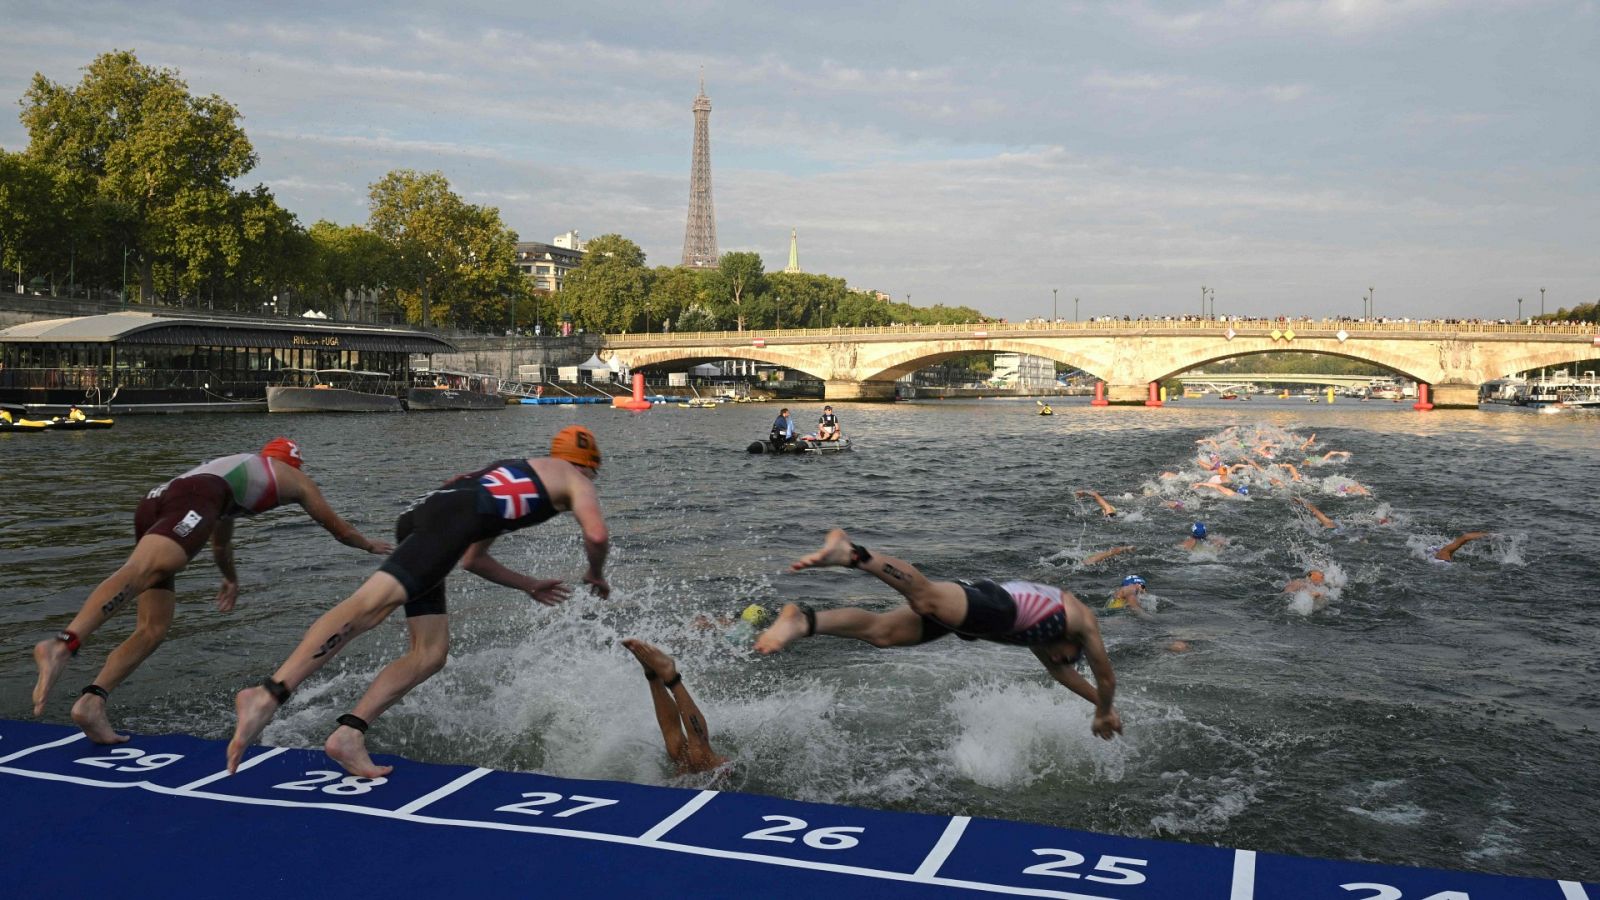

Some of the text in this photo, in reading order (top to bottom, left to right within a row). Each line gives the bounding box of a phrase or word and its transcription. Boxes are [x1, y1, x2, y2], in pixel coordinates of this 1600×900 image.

[321, 336, 340, 347] FUGA
[74, 747, 184, 773] 29
[273, 770, 389, 796] 28
[494, 791, 620, 818] 27
[743, 815, 866, 850] 26
[1023, 848, 1148, 885] 25
